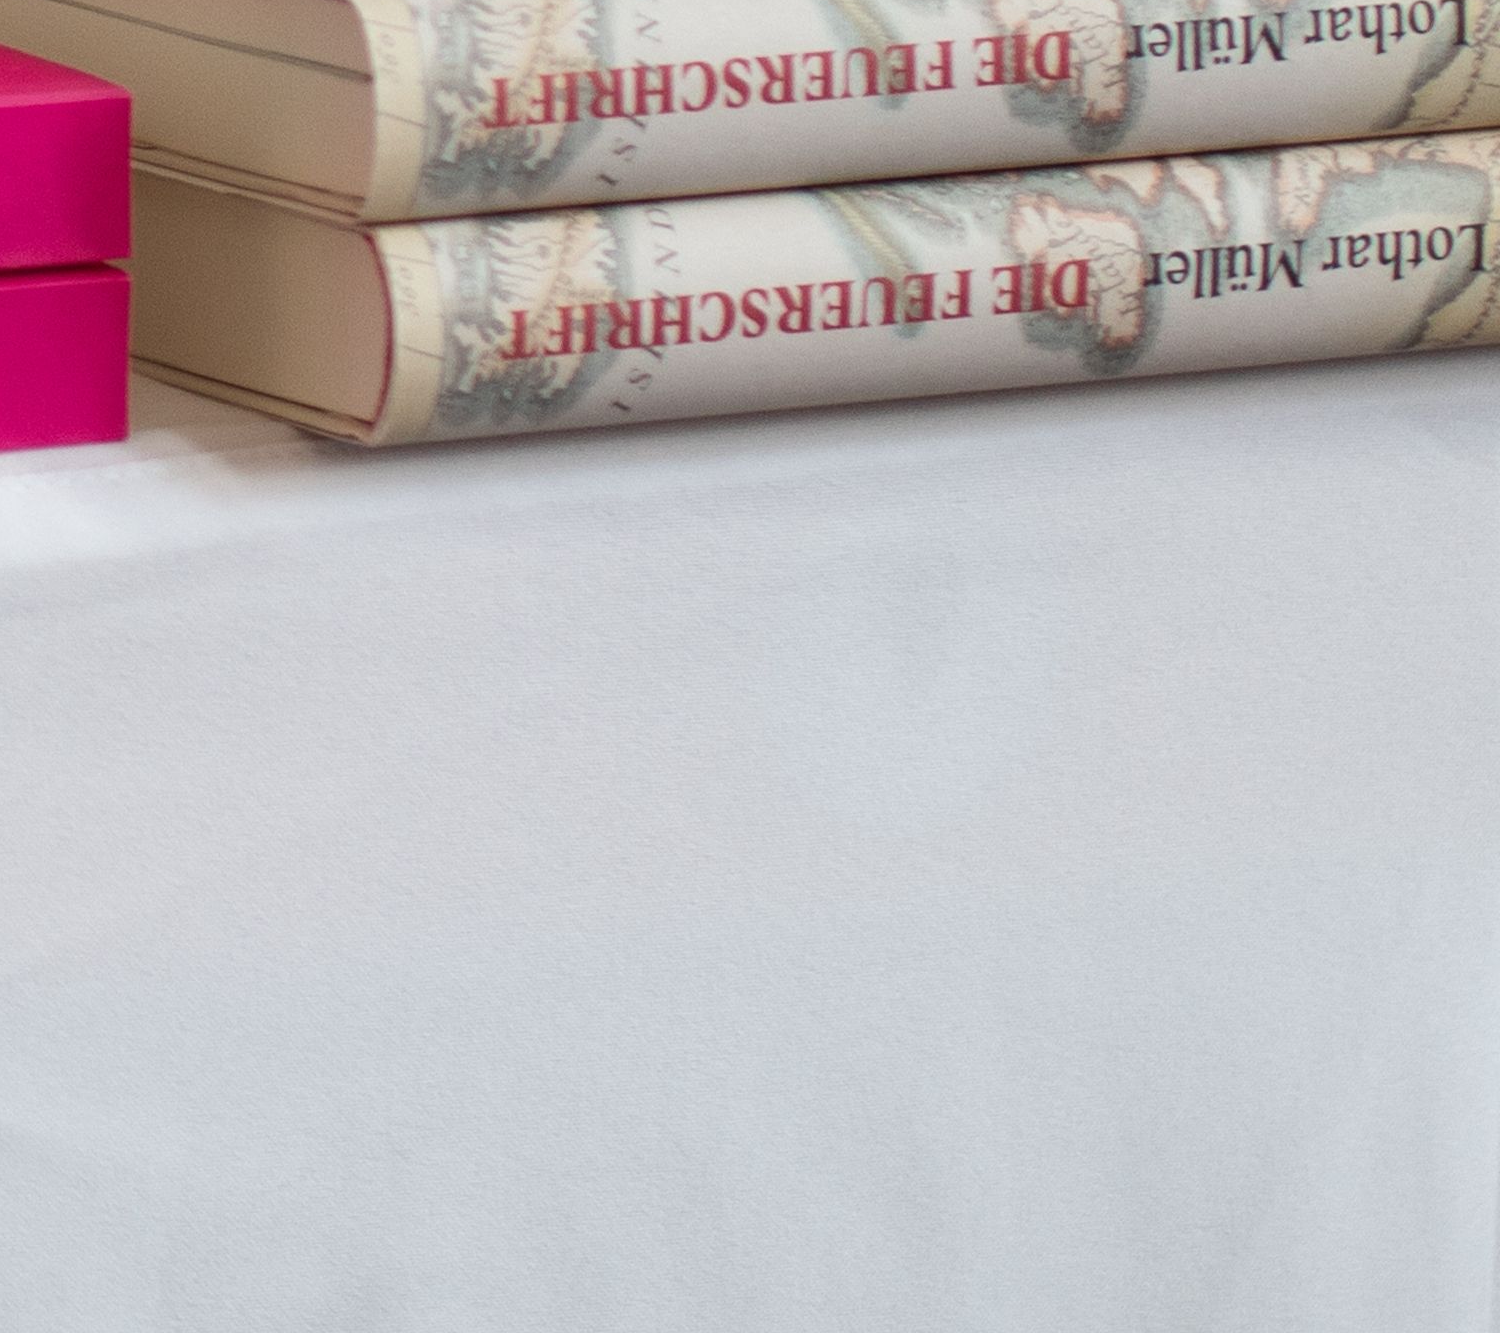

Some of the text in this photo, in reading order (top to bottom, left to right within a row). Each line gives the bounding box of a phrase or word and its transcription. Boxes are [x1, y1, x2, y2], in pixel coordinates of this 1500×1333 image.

[483, 30, 1074, 130] DIE FEUERSCHRIFT
[1125, 11, 1289, 73] Müller
[1143, 222, 1489, 300] Lothar Müller
[499, 259, 1093, 360] DIE FEUERSCHRIFT
